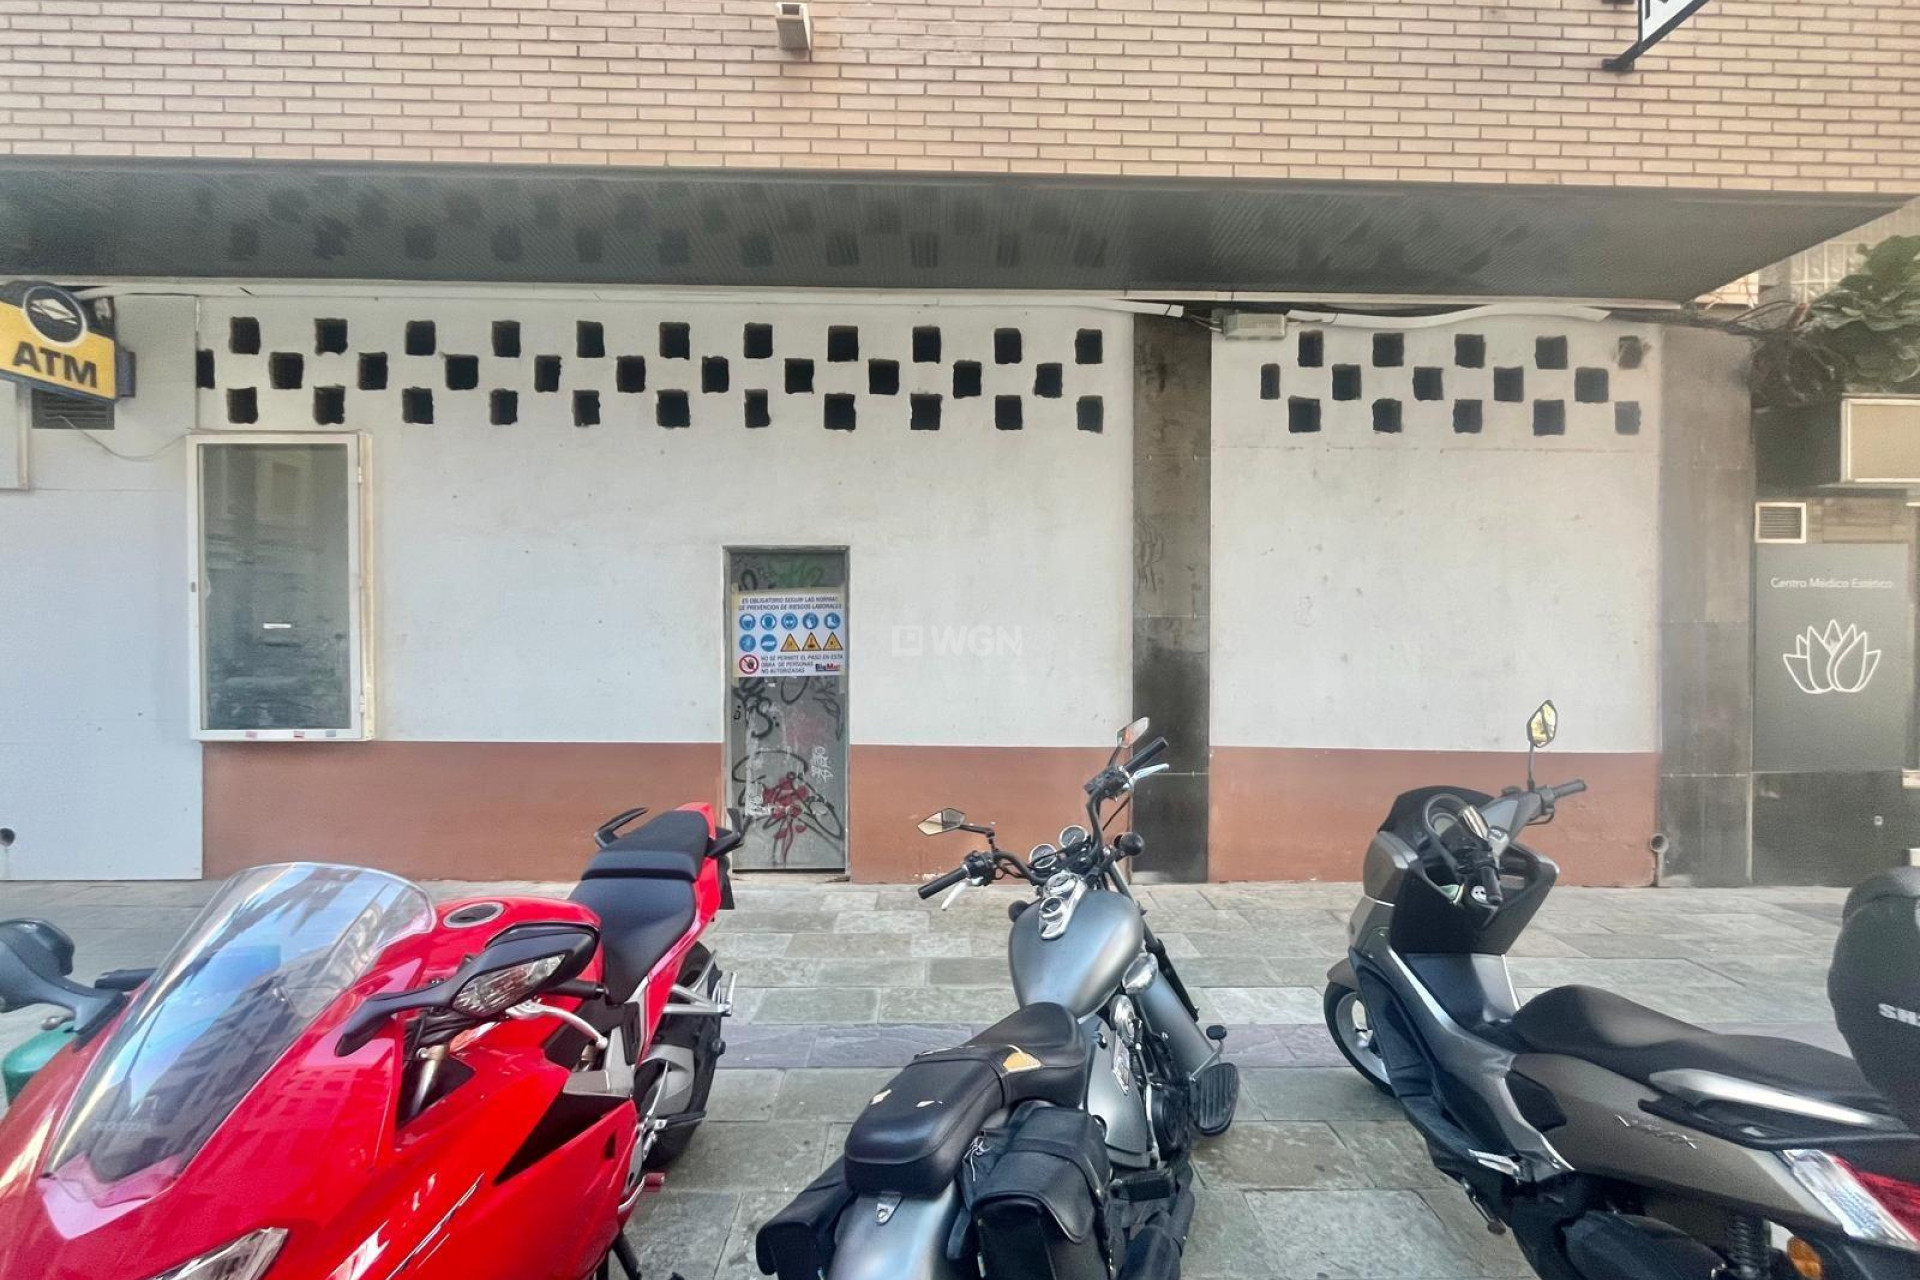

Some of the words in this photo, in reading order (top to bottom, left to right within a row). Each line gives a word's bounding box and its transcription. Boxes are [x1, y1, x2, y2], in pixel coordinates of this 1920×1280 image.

[12, 340, 98, 389] ATM
[1770, 577, 1807, 588] Centro
[1878, 1003, 1920, 1027] SH
